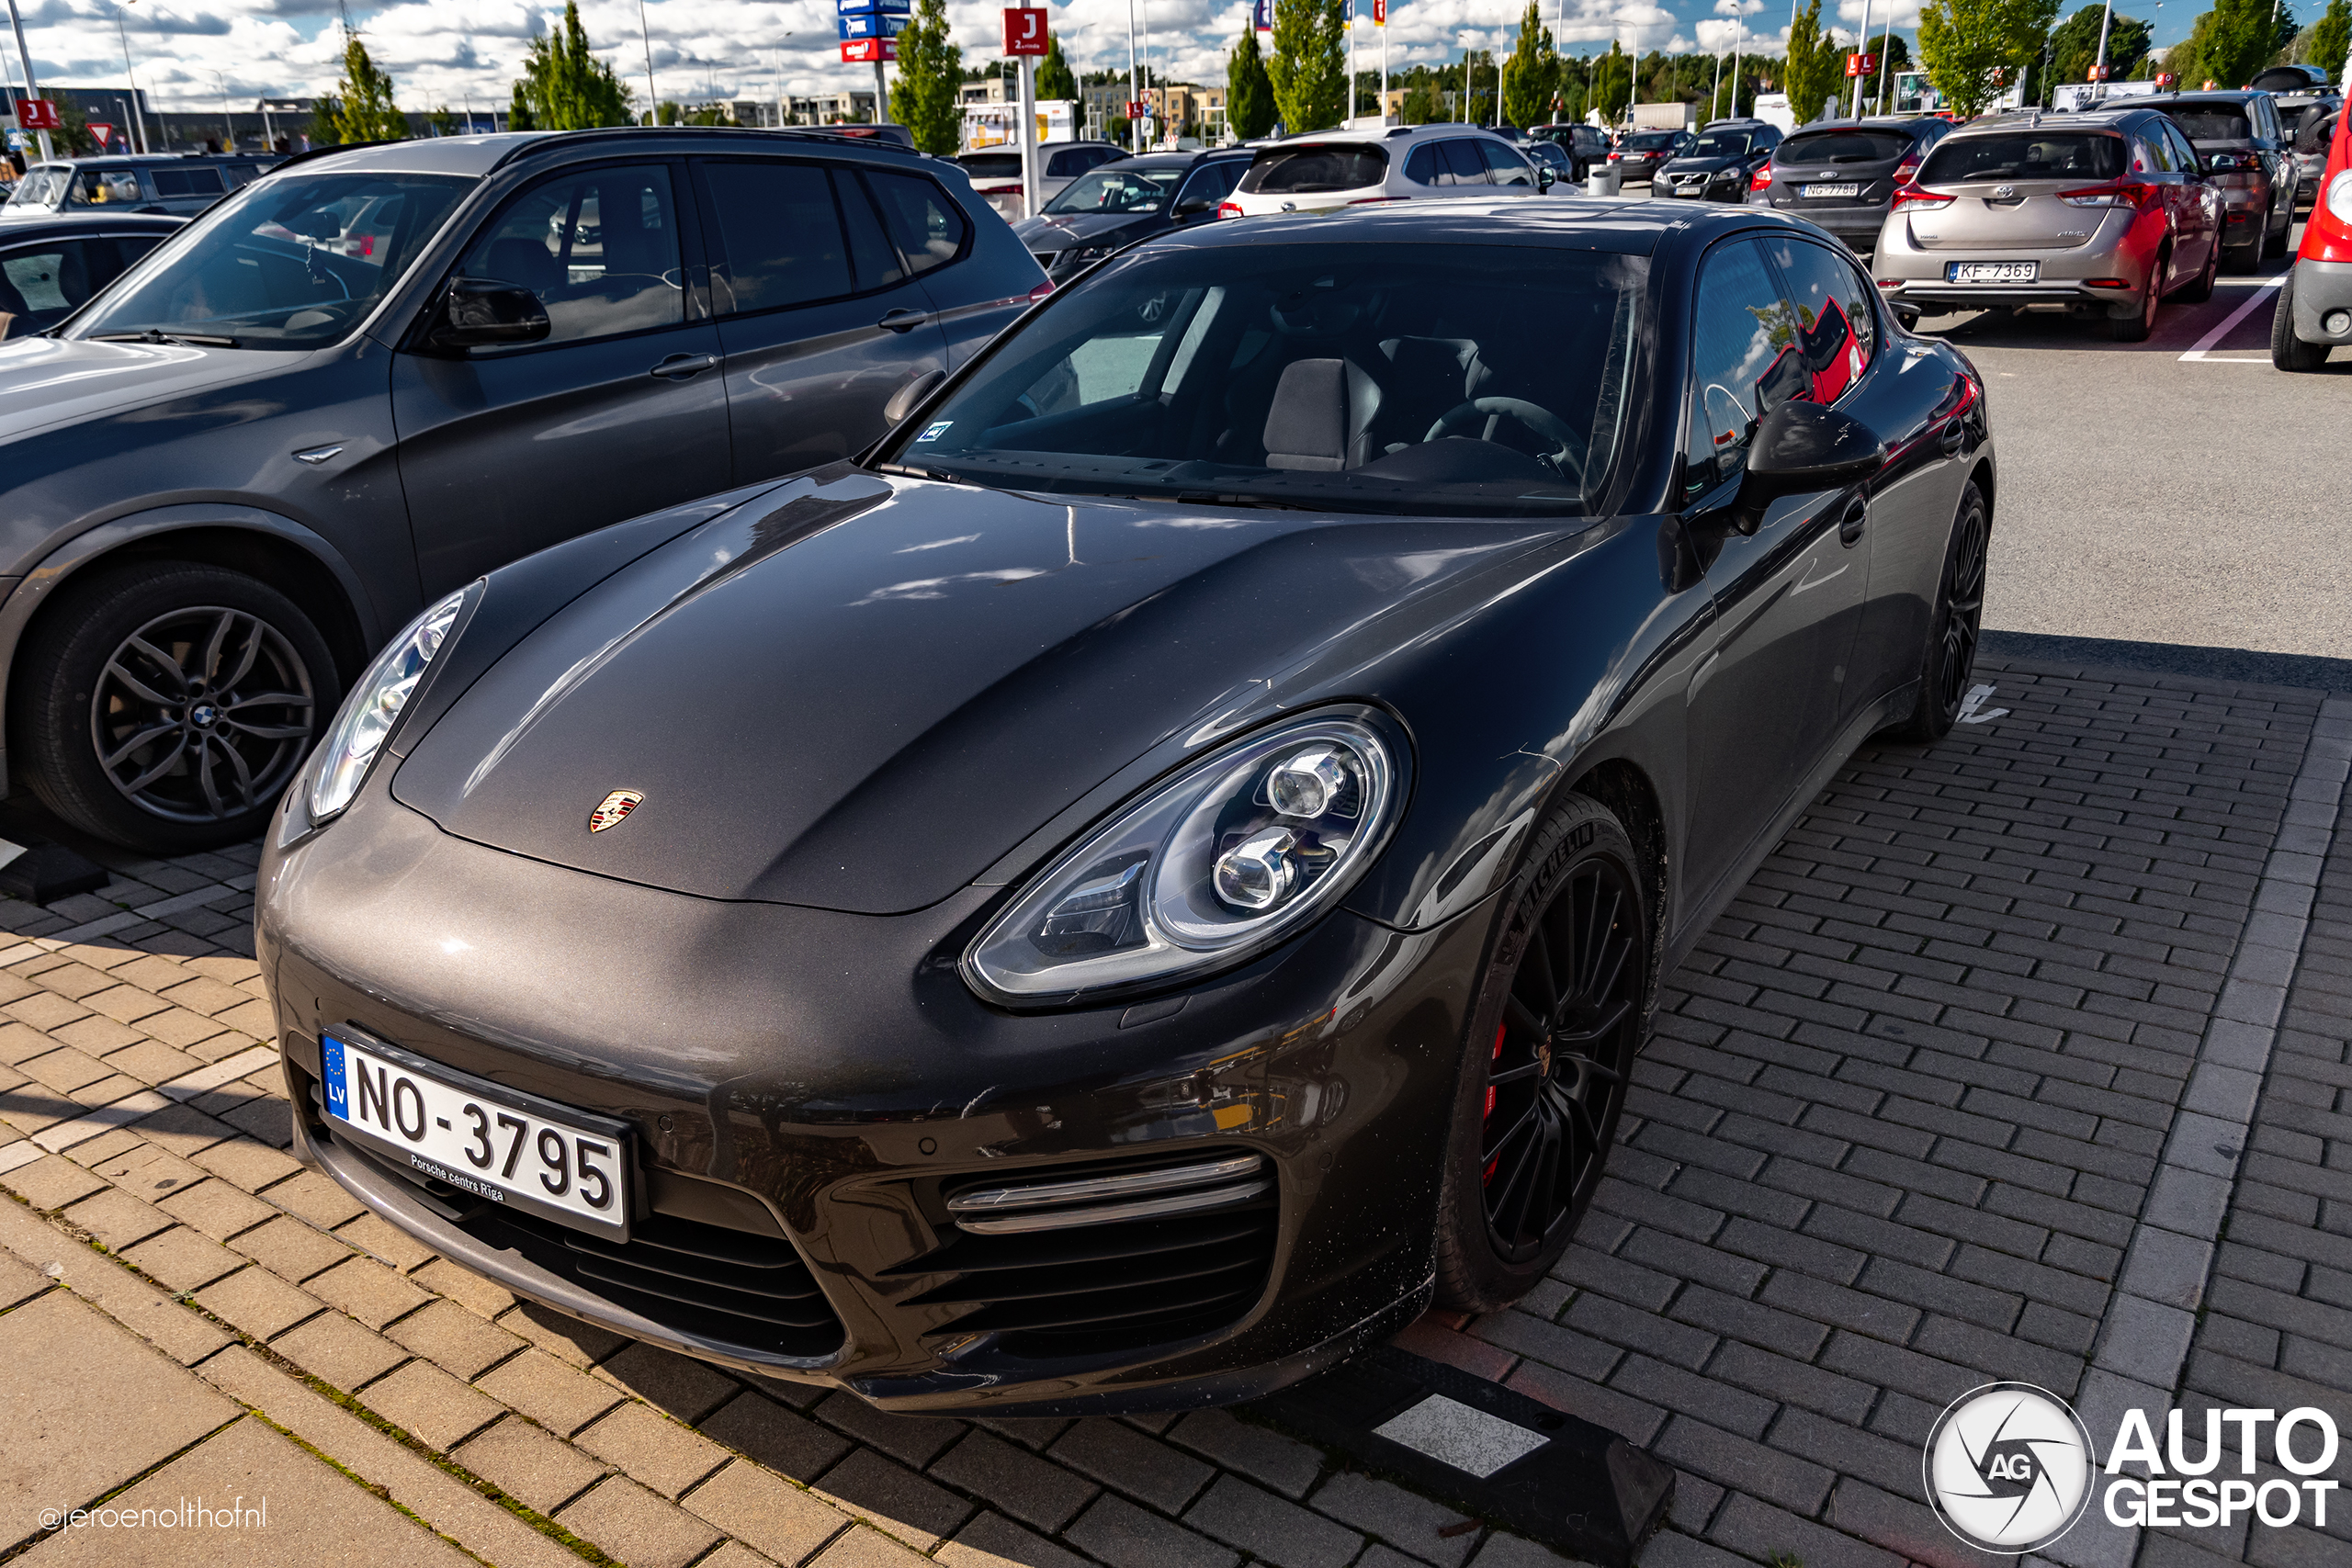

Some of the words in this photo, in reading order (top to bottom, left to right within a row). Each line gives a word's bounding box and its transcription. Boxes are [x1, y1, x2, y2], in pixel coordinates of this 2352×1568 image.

[1022, 14, 1036, 39] J
[1863, 56, 1871, 68] L
[2099, 67, 2107, 75] N
[28, 103, 39, 119] J
[48, 103, 58, 118] K
[1133, 104, 1140, 113] L
[1807, 185, 1856, 195] NG-7786
[1961, 264, 2032, 277] KF-7369
[1519, 821, 1593, 924] MICHELIN
[328, 1082, 345, 1105] LV
[356, 1056, 613, 1211] NO-3795
[411, 1154, 447, 1179] Porsche
[448, 1172, 479, 1192] centrs
